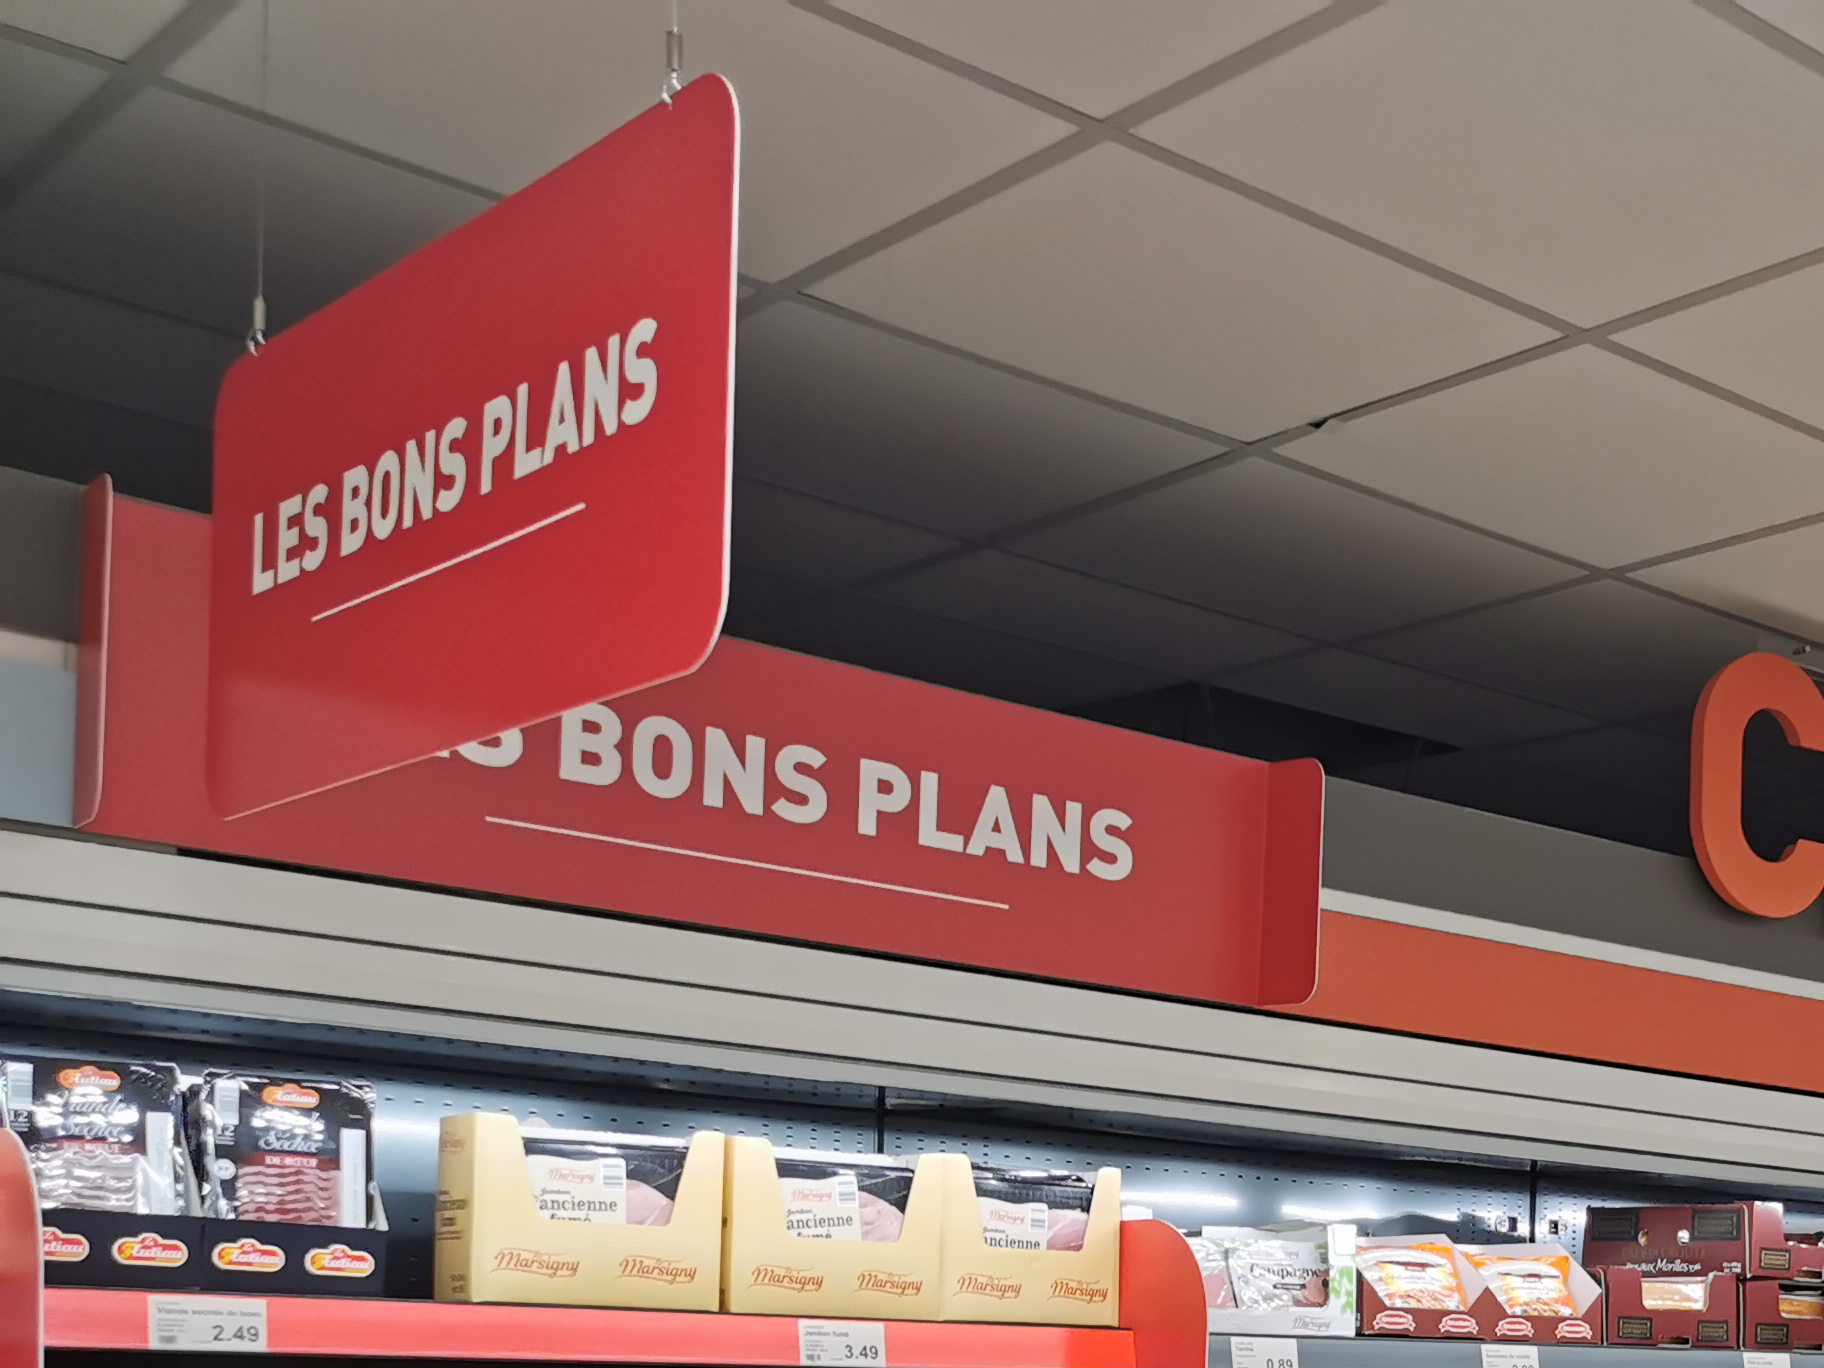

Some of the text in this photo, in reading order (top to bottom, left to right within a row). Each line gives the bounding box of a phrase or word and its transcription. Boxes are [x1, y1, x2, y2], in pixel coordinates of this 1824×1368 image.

[252, 318, 658, 595] LES BONS PLANS
[559, 702, 1134, 881] BONS PLANS
[494, 1251, 580, 1279] Marsigny
[619, 1257, 697, 1284] Marsigny
[752, 1266, 824, 1293] Marsigny
[857, 1272, 923, 1298] Marsigny
[957, 1276, 1022, 1300] Marsigny
[1051, 1281, 1108, 1304] Marsigny
[211, 1325, 260, 1343] 2.49
[844, 1344, 879, 1360] 3.49
